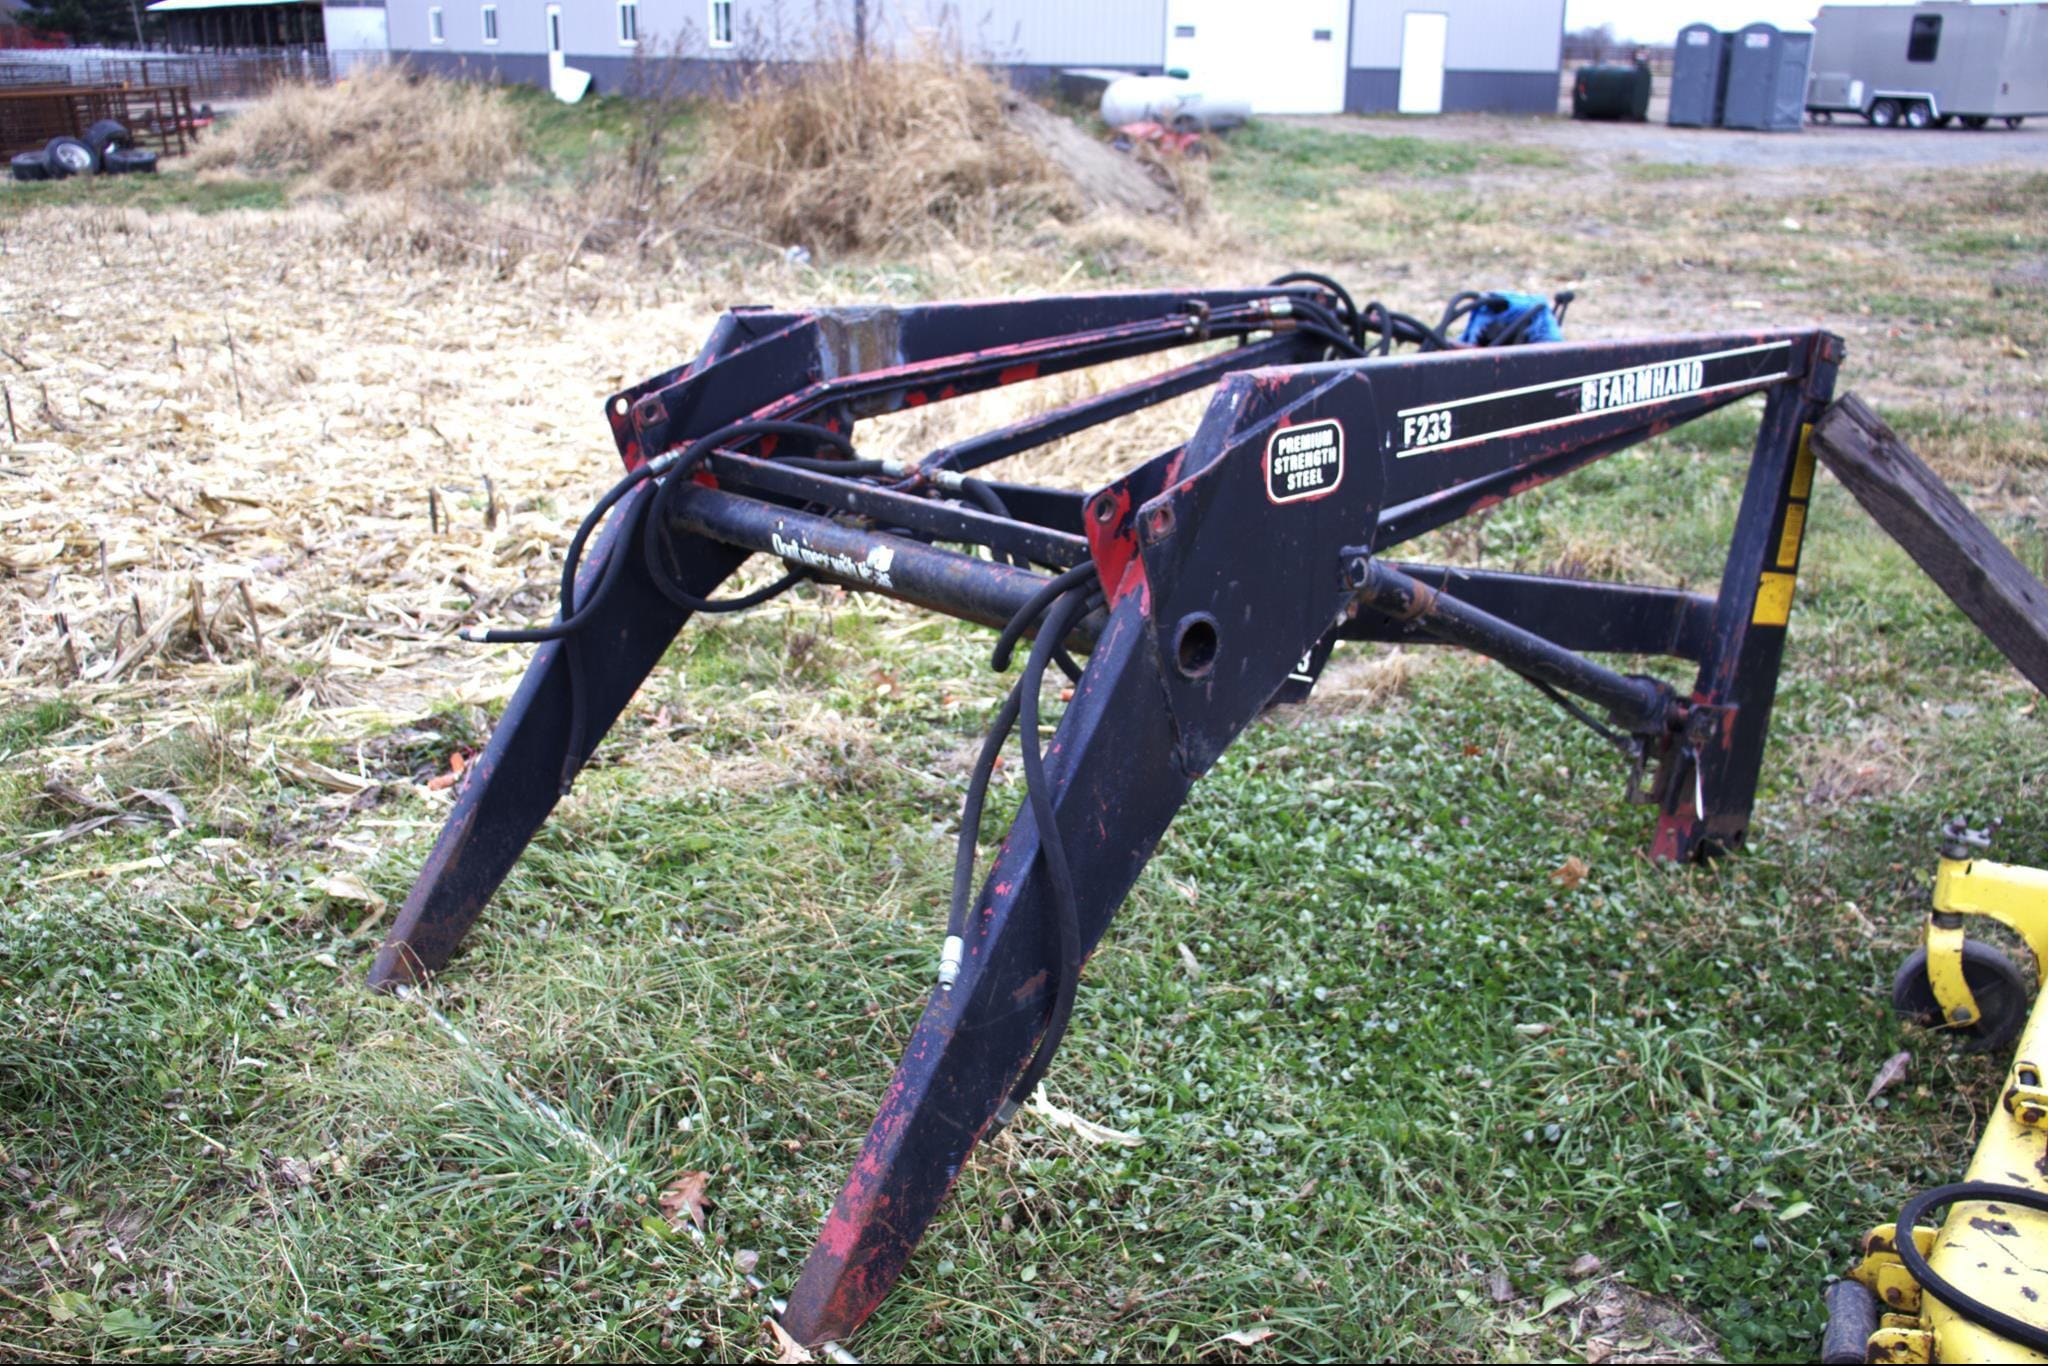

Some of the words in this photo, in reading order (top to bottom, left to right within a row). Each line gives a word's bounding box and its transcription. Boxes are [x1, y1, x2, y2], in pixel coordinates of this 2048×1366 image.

[1599, 360, 1704, 409] FARMHAND
[1278, 429, 1333, 456] PREMIUM
[1404, 410, 1452, 448] F233
[1274, 446, 1337, 475] STRENGTH
[1287, 467, 1324, 491] STEEL
